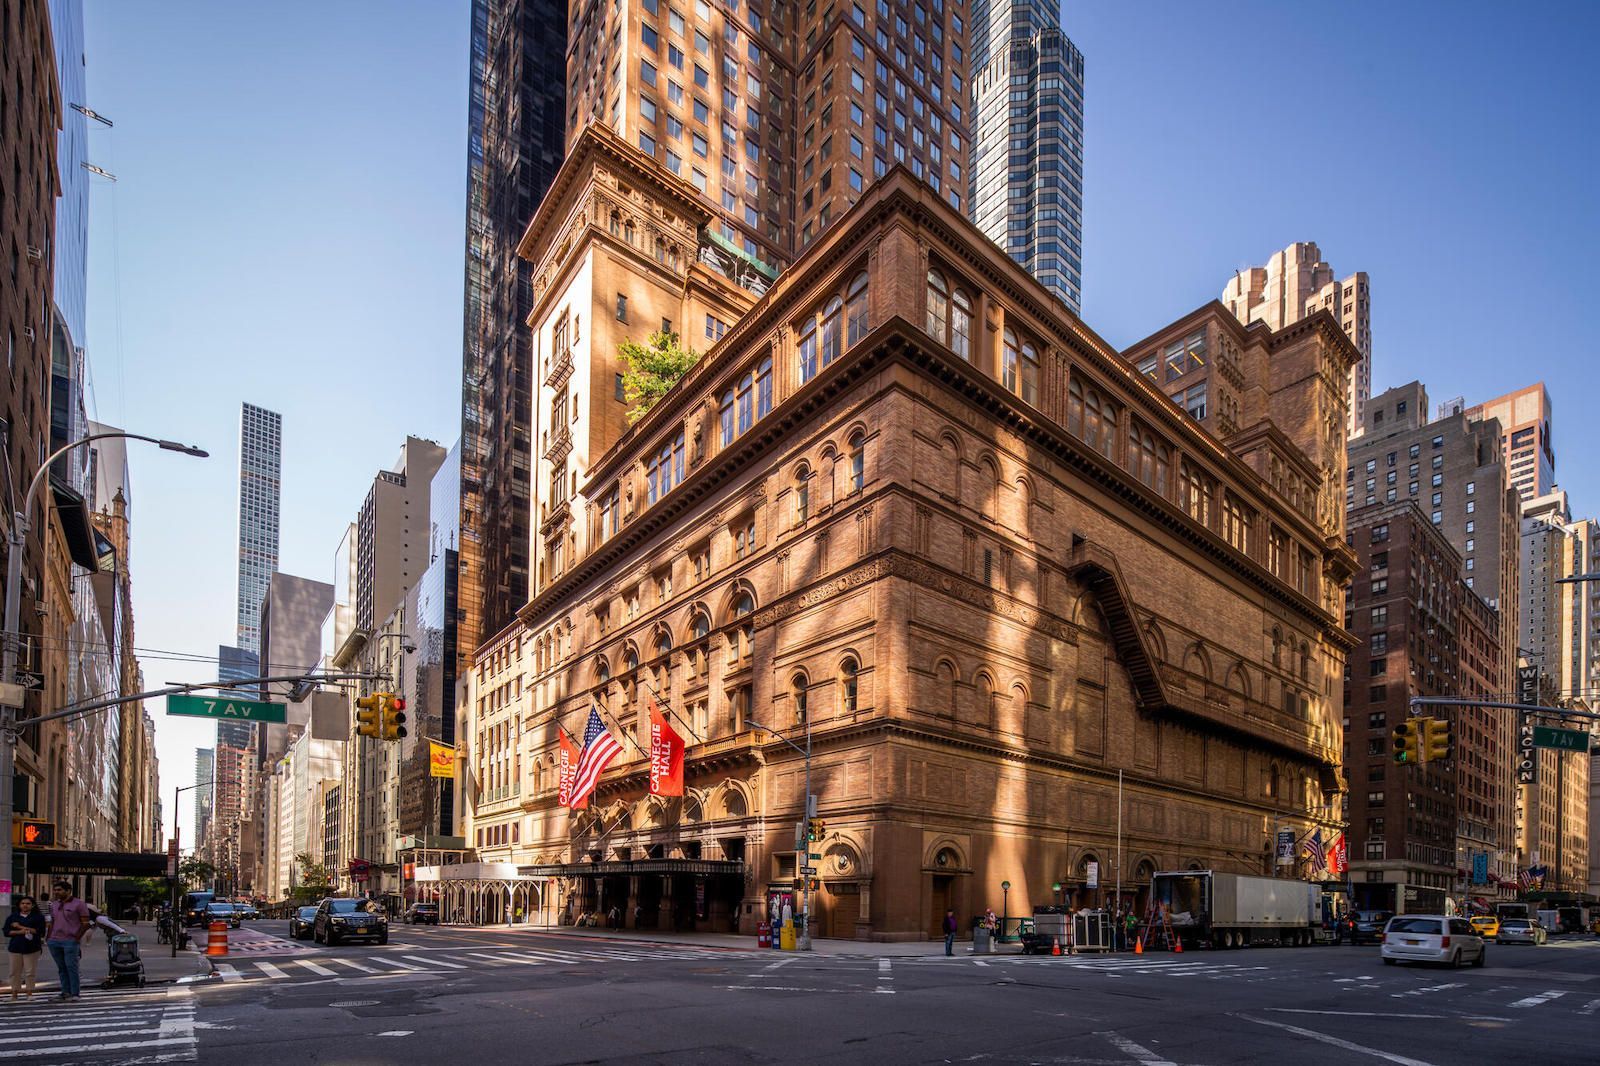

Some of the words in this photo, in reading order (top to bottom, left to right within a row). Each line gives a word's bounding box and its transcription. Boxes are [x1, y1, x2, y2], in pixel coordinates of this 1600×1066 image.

[204, 701, 216, 713] 7
[224, 703, 252, 717] Av
[1520, 669, 1536, 780] WELINGTON
[652, 724, 661, 792] CARNEGIE
[661, 742, 670, 776] HALL
[1551, 732, 1558, 745] 7
[1560, 732, 1574, 747] Av
[560, 749, 569, 805] CARNEGIE
